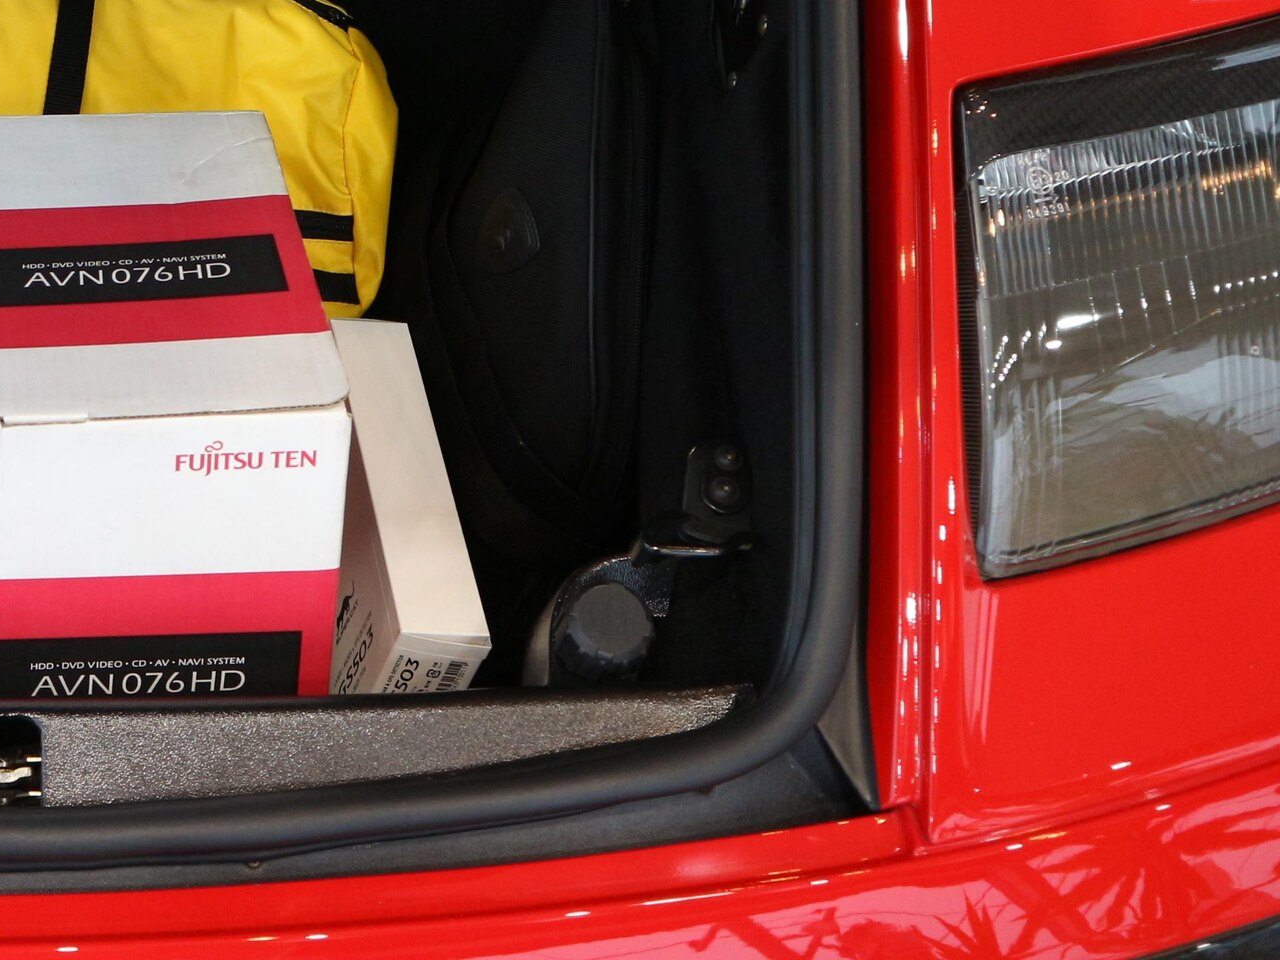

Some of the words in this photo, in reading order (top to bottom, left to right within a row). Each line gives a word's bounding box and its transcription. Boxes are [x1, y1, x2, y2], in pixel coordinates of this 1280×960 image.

[163, 255, 188, 263] NAVI
[190, 253, 227, 261] SYSTEM
[175, 440, 264, 477] FUJITSU
[270, 450, 318, 469] TEN
[30, 662, 54, 670] HDD
[88, 660, 123, 668] VIDEO
[132, 659, 146, 667] CD
[178, 658, 204, 666] NAVI
[207, 656, 245, 665] SYSTEM
